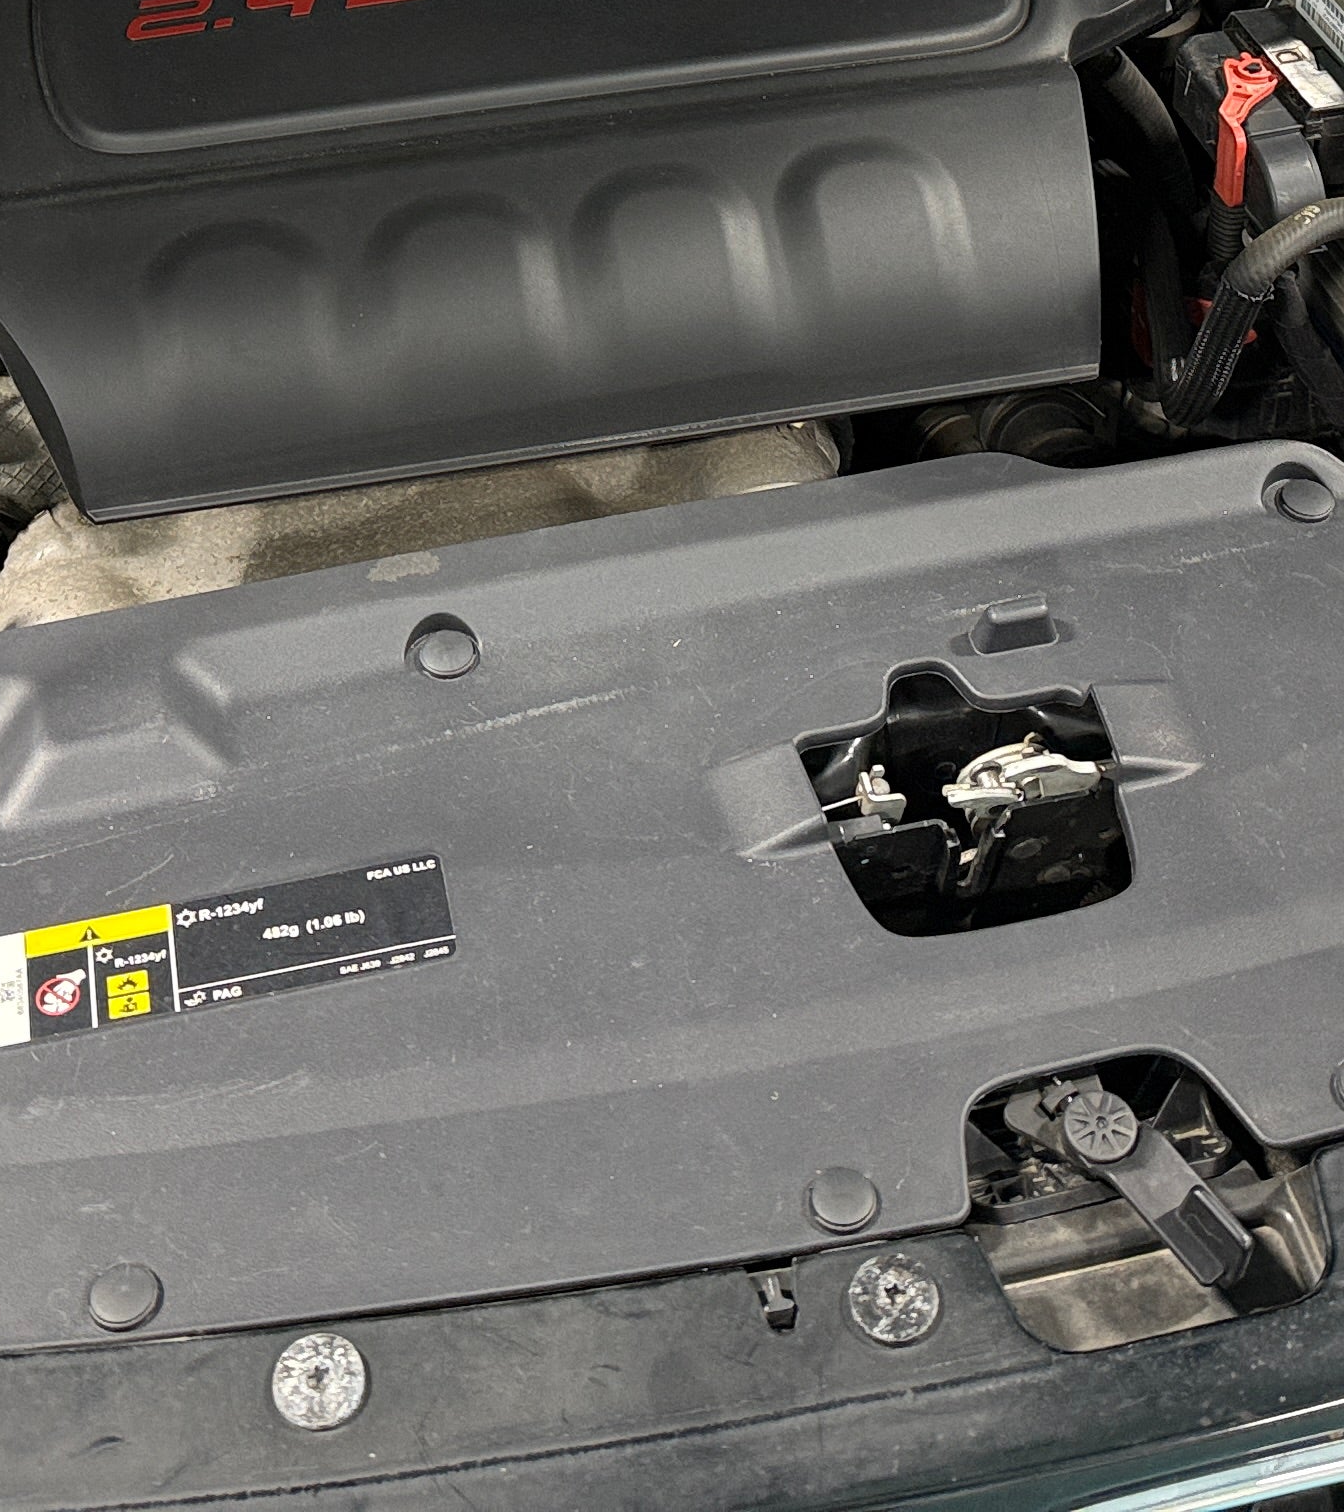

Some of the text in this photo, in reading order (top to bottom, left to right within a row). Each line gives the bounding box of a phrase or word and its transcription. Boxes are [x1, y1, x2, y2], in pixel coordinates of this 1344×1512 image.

[366, 858, 437, 881] FCA US LLC
[198, 897, 265, 922] R-1234yf
[344, 909, 366, 925] lb)
[114, 948, 167, 969] R-1234yf
[212, 985, 243, 1002] PAG
